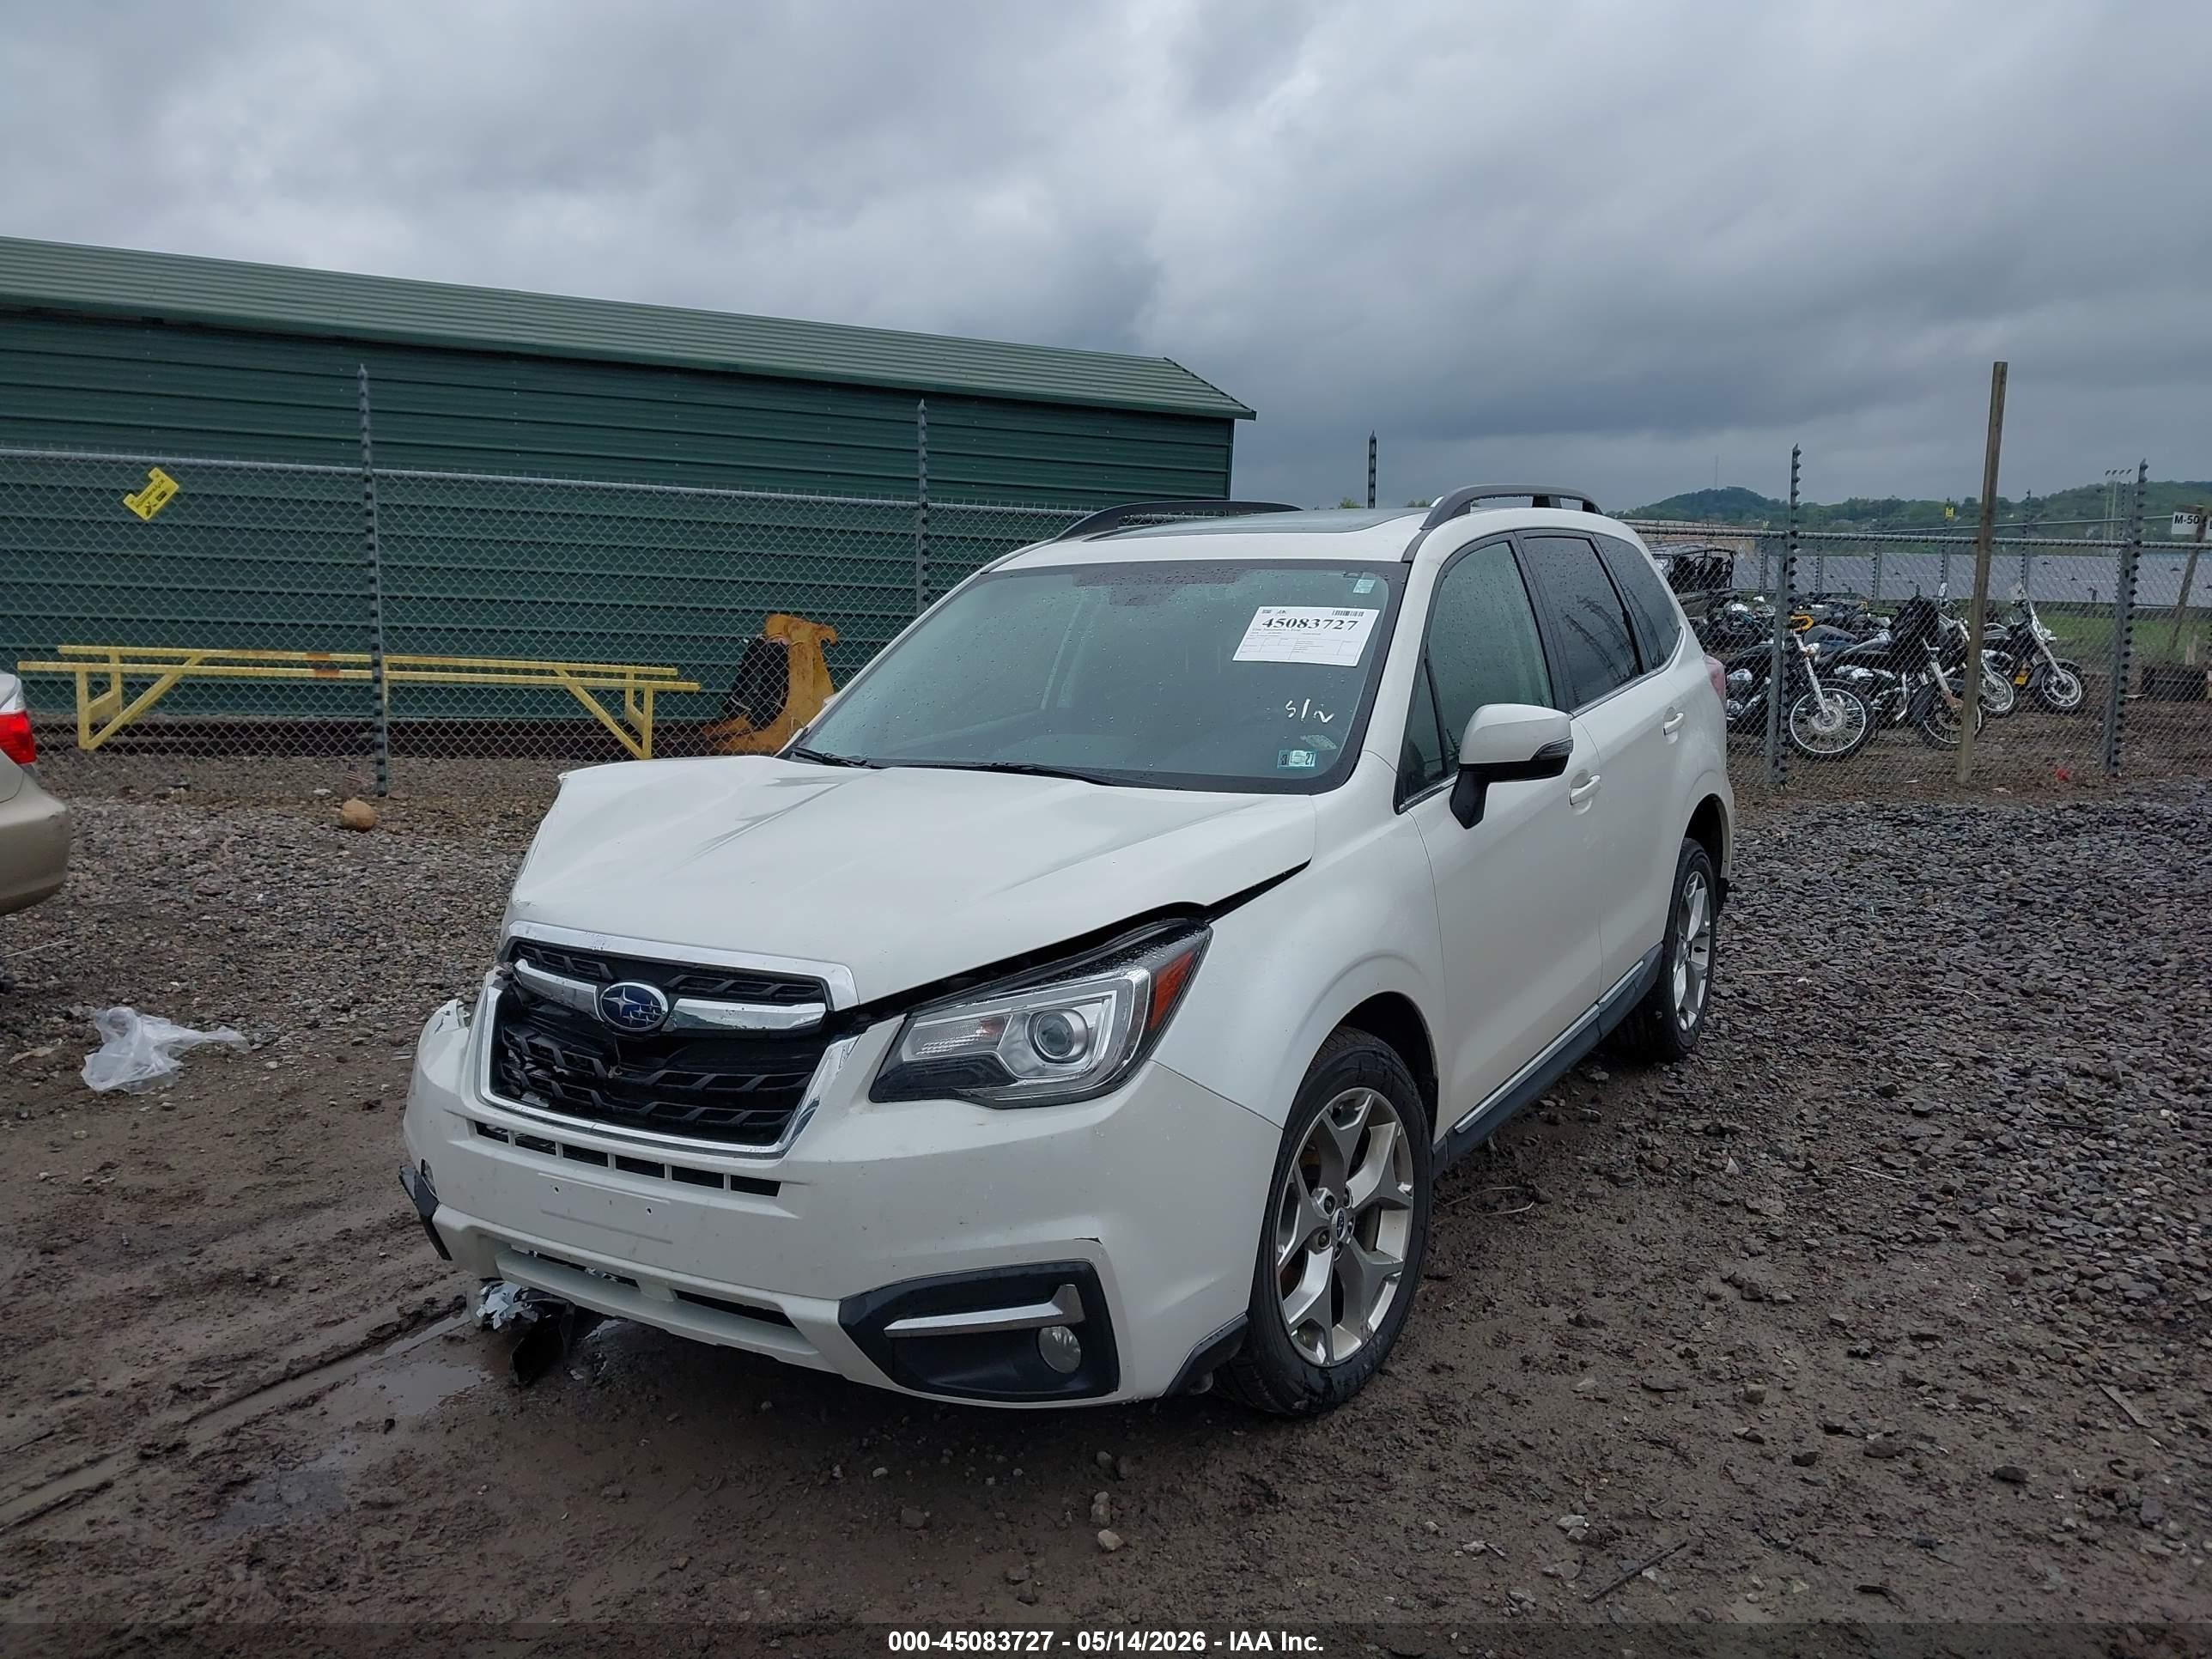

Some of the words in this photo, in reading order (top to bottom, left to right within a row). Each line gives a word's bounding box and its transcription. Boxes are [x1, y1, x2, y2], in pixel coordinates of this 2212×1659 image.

[2174, 514, 2200, 525] M-50
[1262, 617, 1359, 631] 45083727
[1305, 752, 1315, 766] 27
